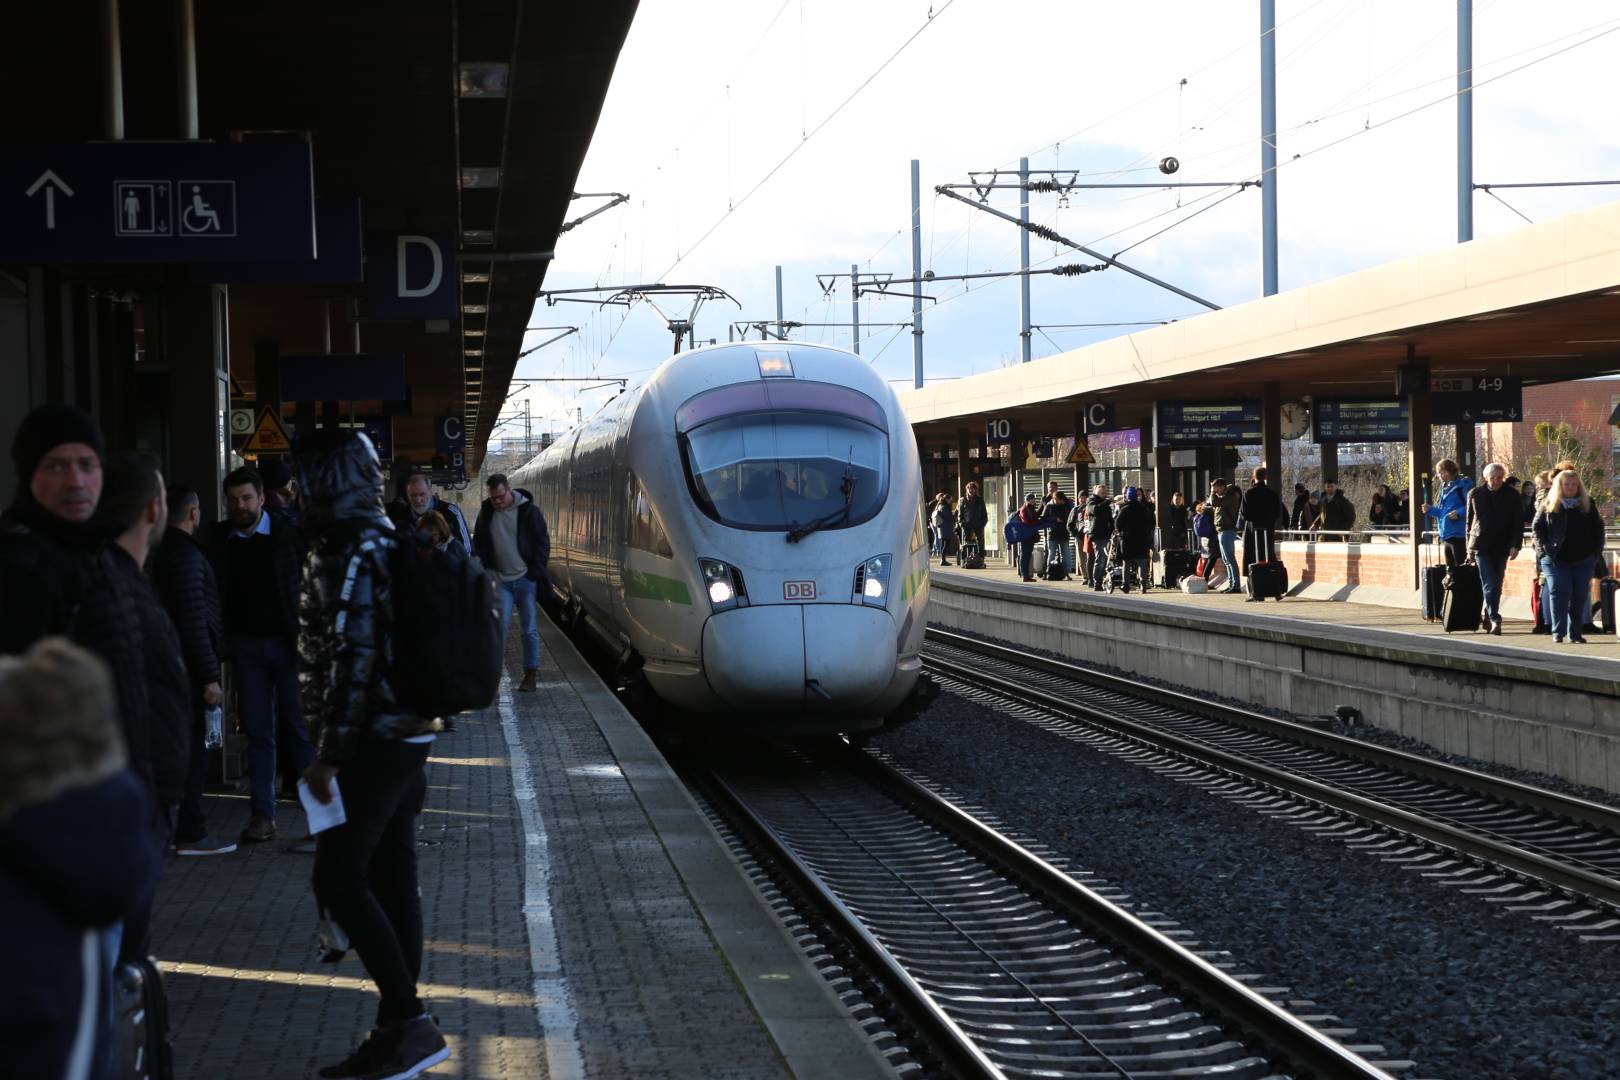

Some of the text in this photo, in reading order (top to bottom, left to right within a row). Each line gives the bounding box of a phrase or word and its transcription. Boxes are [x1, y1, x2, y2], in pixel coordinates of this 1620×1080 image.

[396, 235, 444, 299] D
[1478, 377, 1503, 392] 4-9
[1088, 403, 1106, 427] C
[443, 416, 461, 440] C
[988, 419, 1011, 439] 10
[452, 452, 463, 467] B
[786, 583, 813, 598] DB
